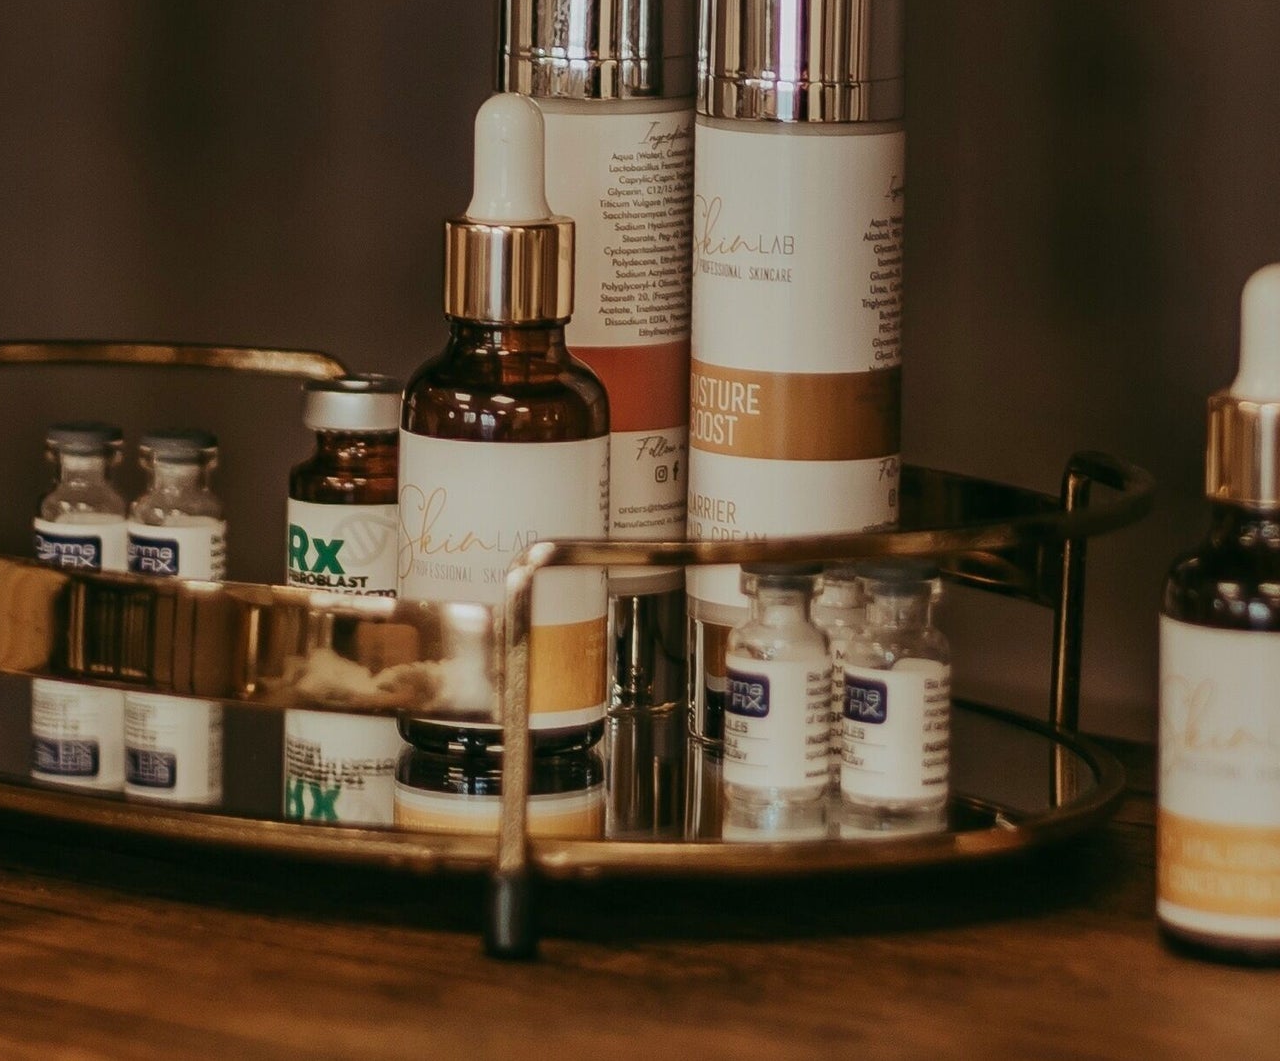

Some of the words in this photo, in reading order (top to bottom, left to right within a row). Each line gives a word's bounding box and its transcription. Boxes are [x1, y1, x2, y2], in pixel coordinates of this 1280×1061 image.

[614, 222, 646, 231] Sodium
[759, 235, 795, 255] LAB
[748, 266, 792, 283] SKINCARE
[691, 373, 761, 415] OISTURE
[399, 484, 496, 579] Skin
[289, 523, 345, 575] Rx
